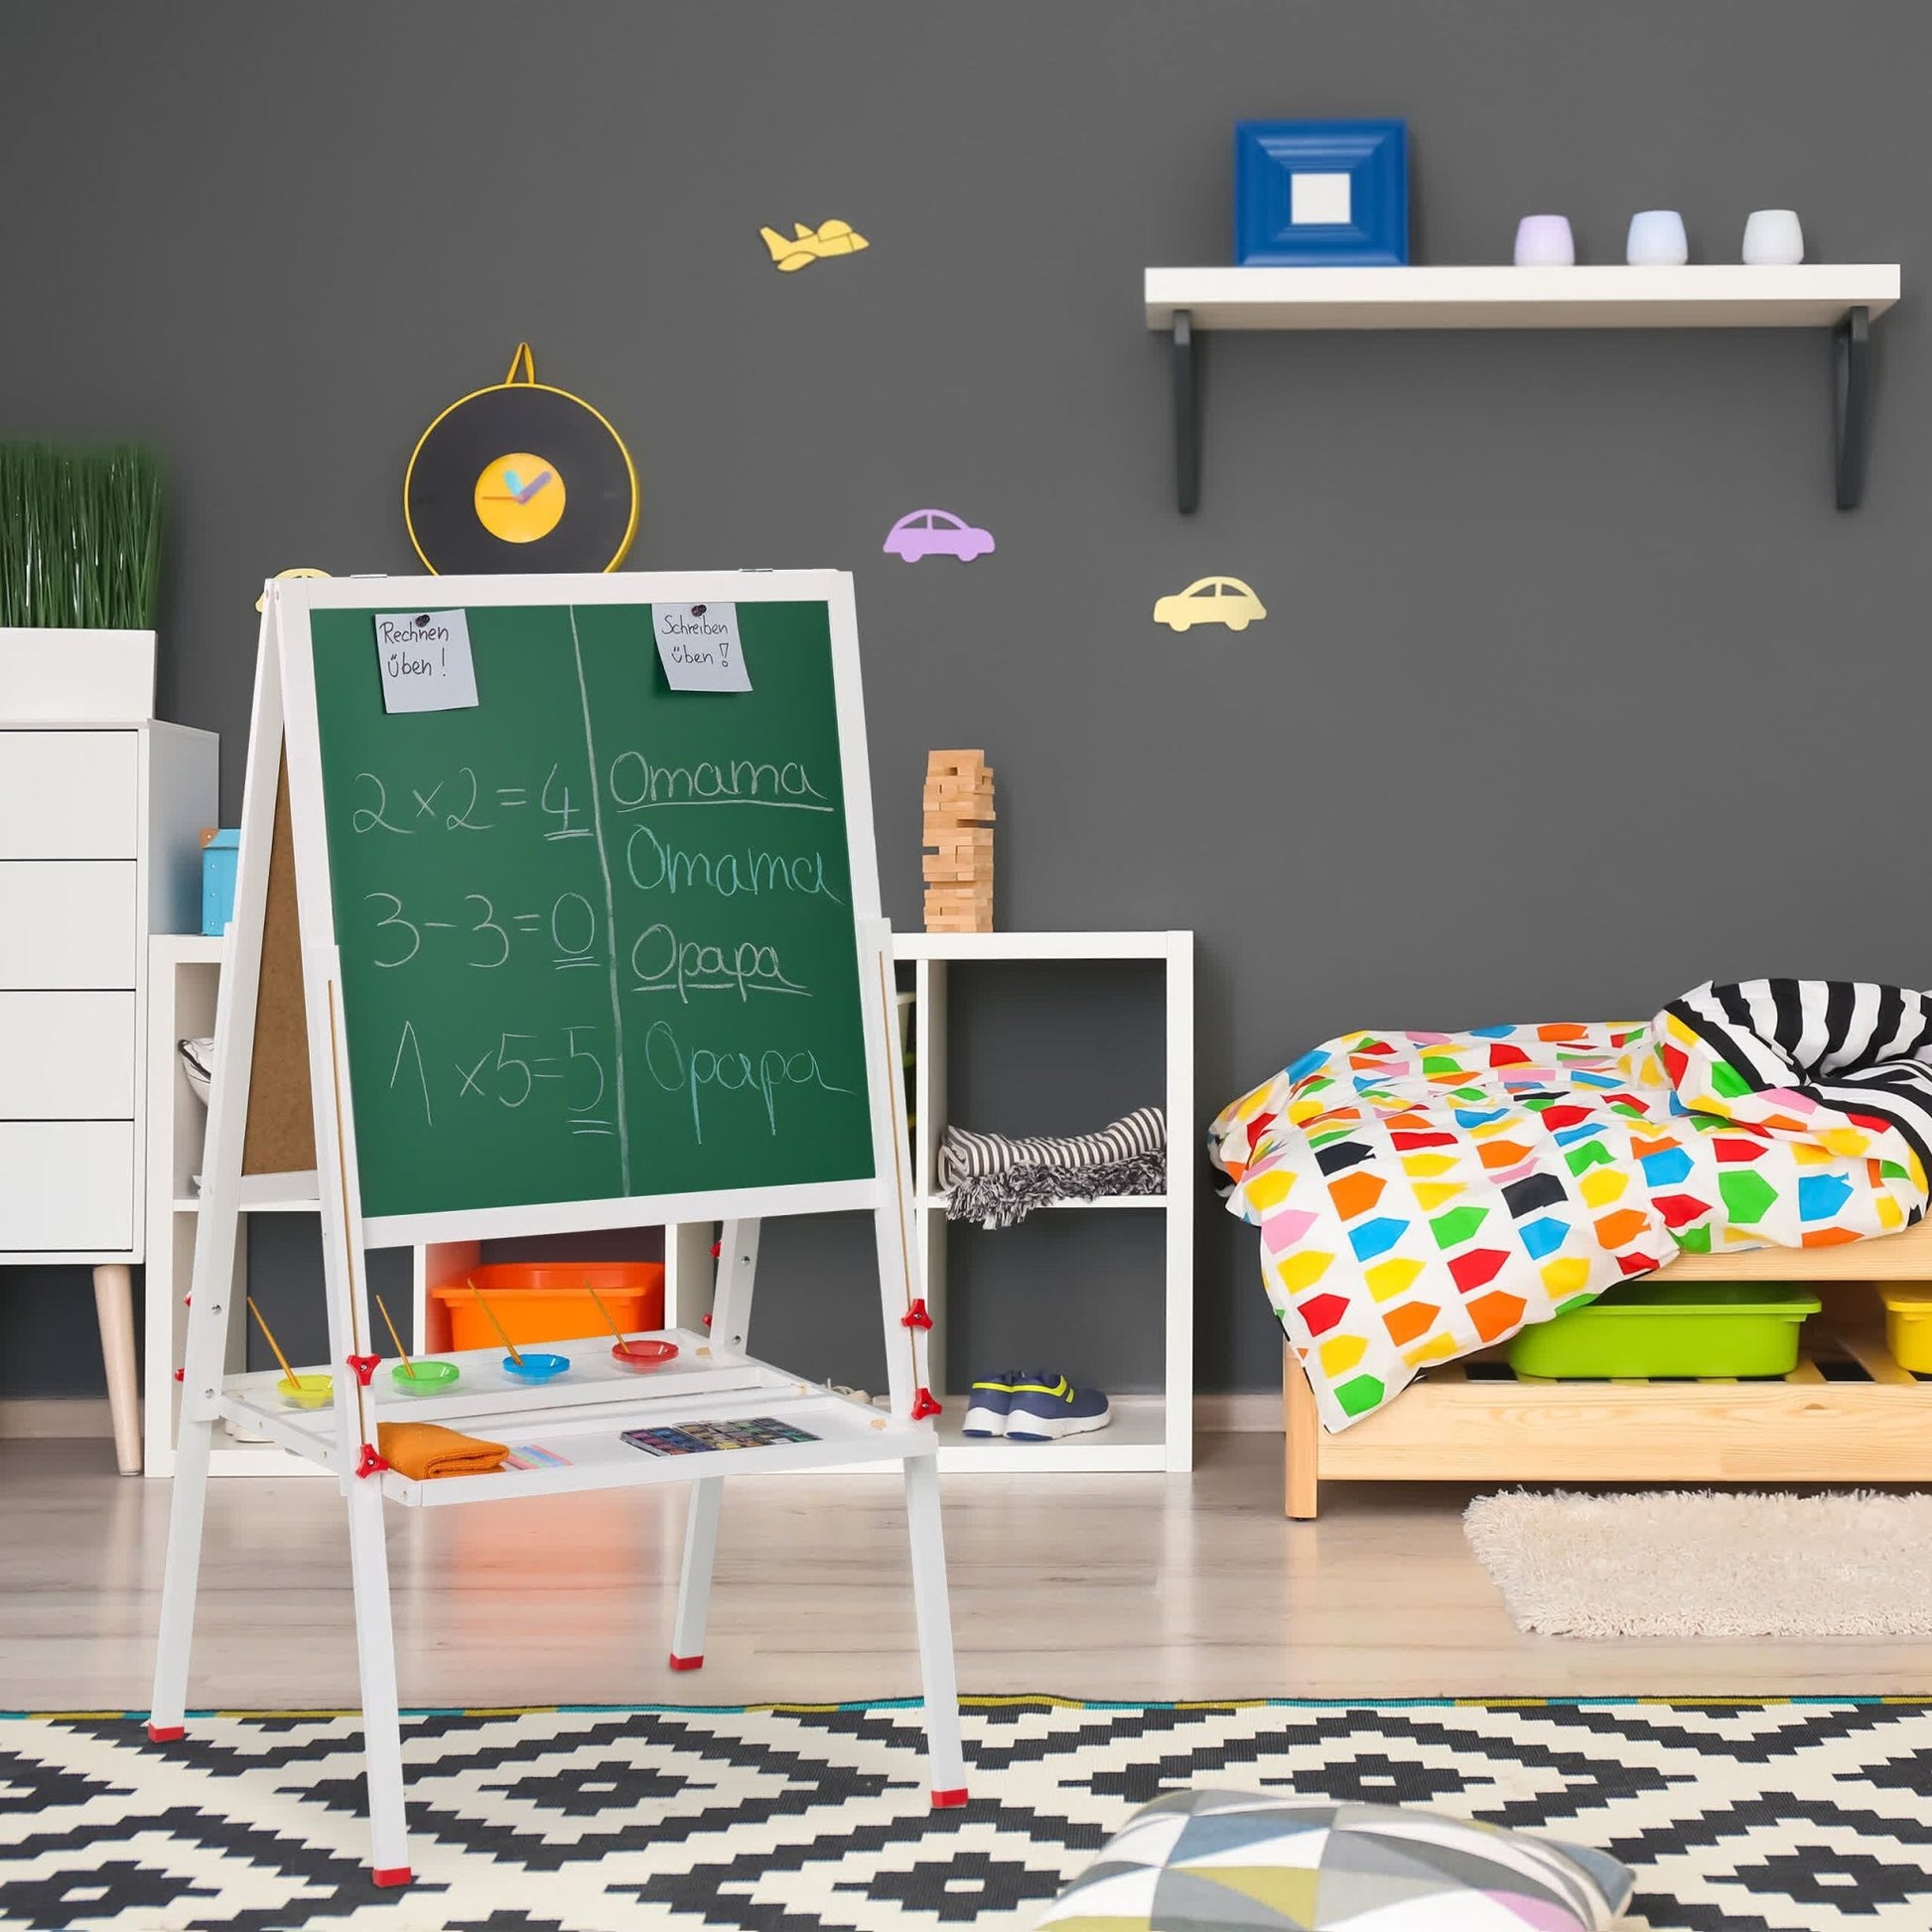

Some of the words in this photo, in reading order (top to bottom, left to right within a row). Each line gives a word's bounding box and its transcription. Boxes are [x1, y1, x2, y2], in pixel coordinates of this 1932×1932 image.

[379, 621, 450, 644] Rechnen
[661, 615, 730, 635] Schreiben
[610, 752, 827, 805] Omama
[627, 824, 845, 905] Omama
[631, 923, 809, 1003] Opapa
[645, 1021, 857, 1145] Opapa
